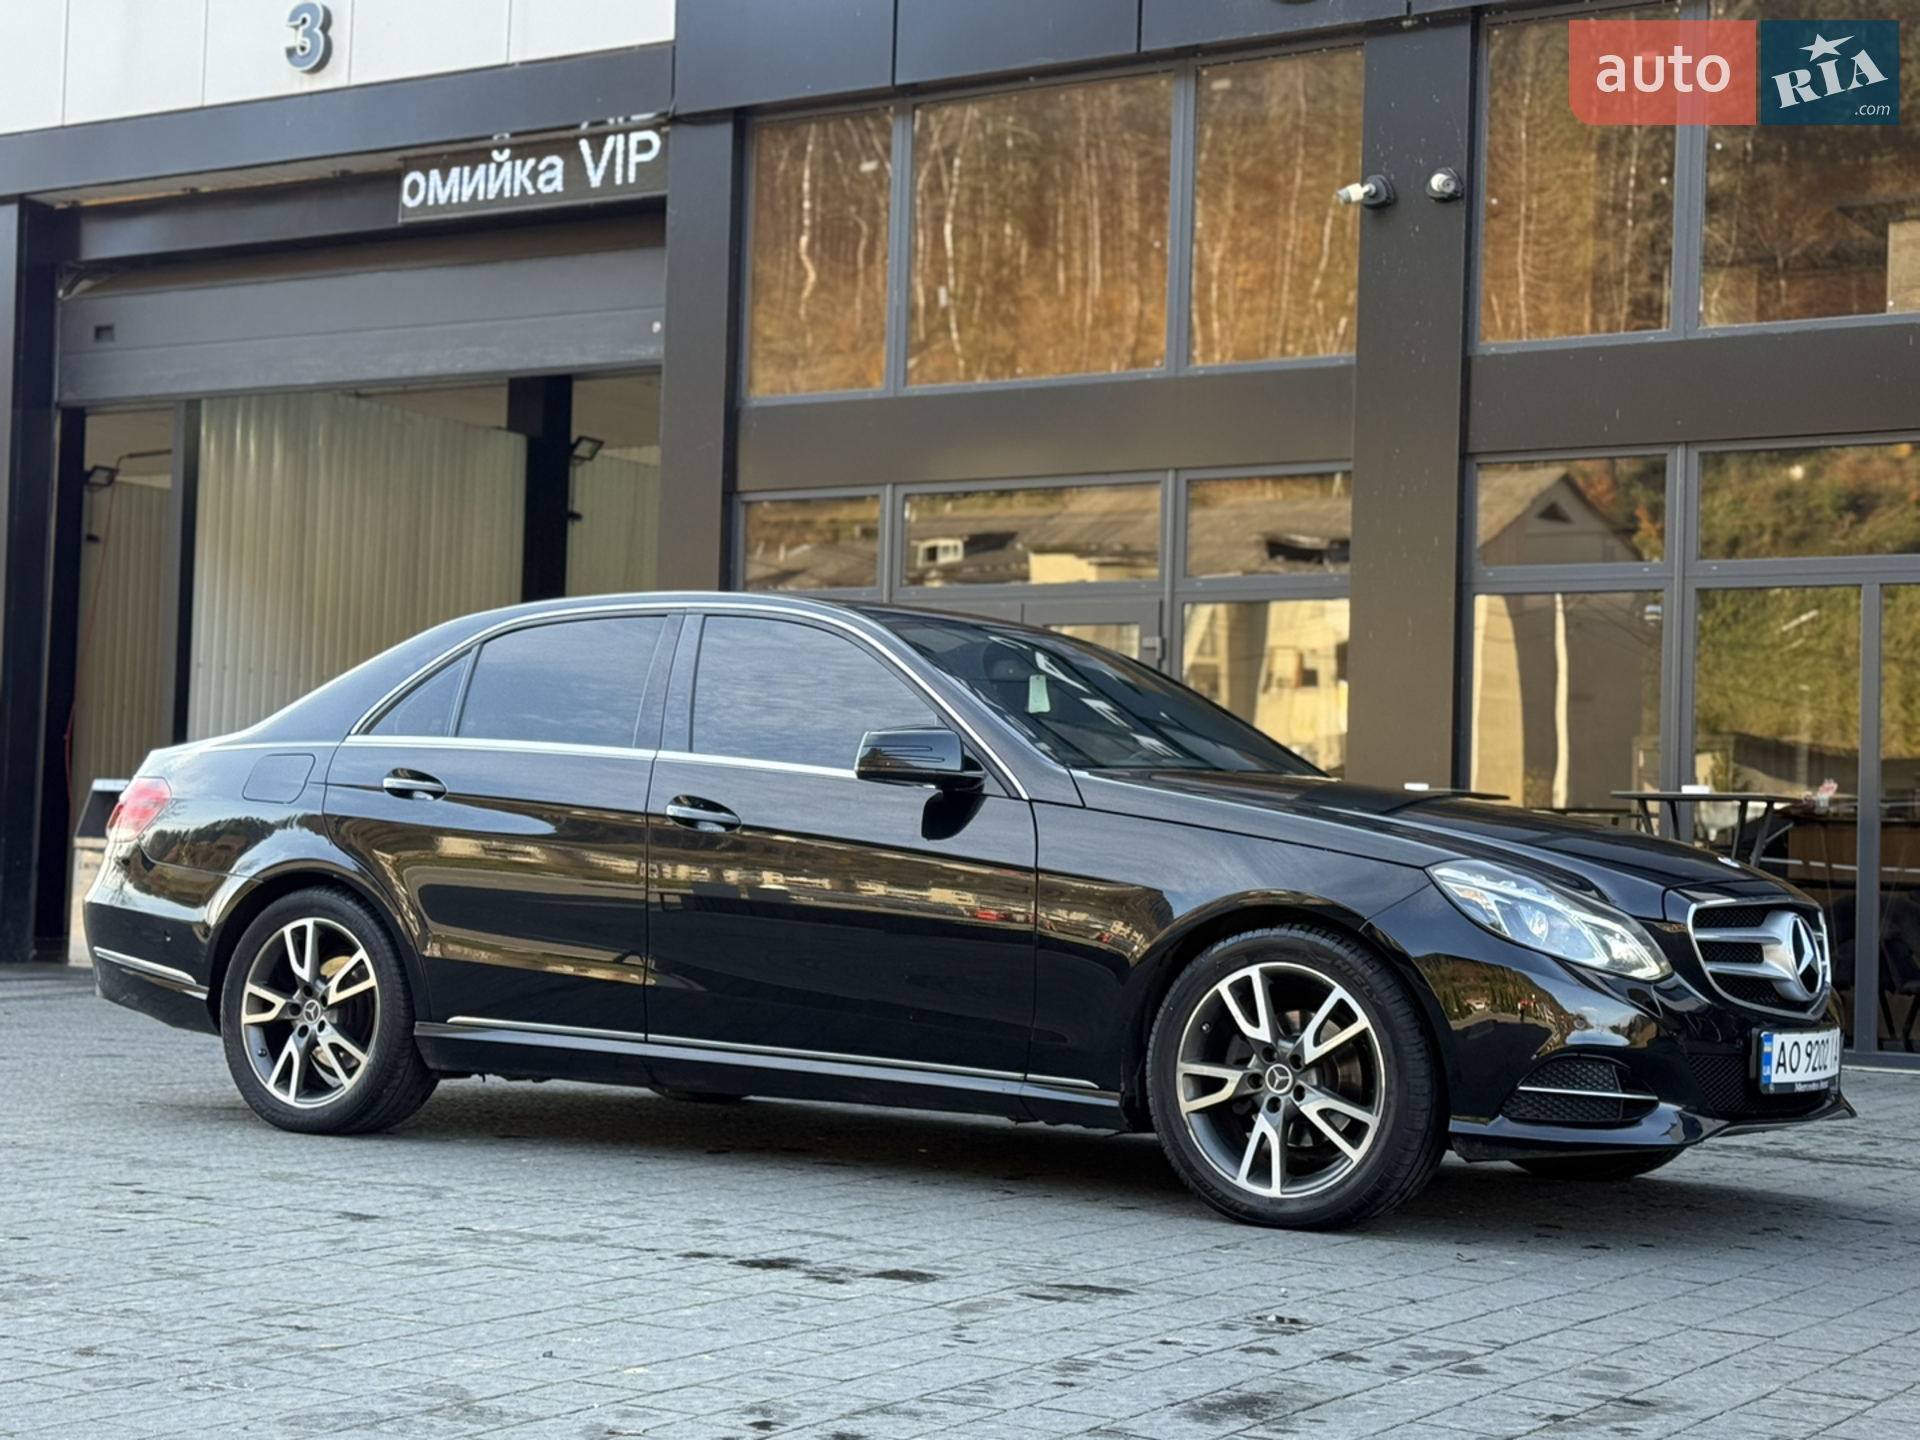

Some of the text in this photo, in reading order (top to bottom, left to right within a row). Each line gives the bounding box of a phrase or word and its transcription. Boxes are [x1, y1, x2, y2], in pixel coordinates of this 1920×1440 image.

[284, 1, 330, 73] 3
[402, 129, 662, 208] омийка VIP
